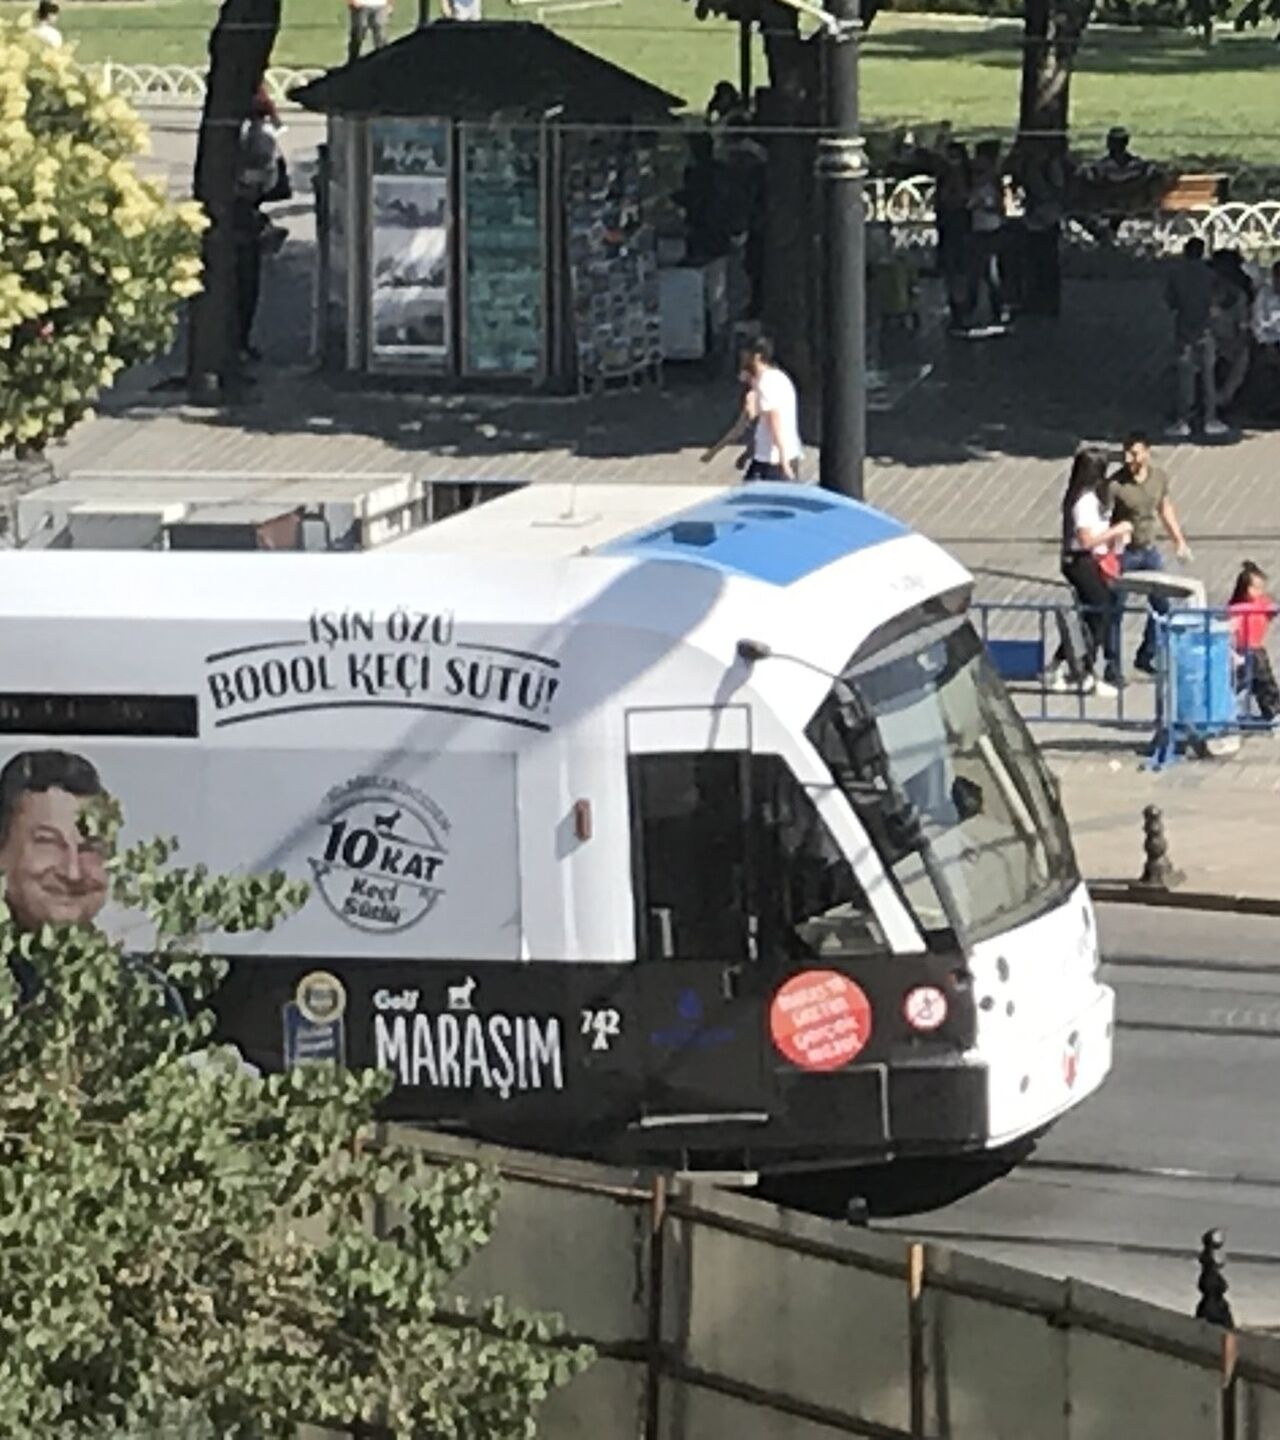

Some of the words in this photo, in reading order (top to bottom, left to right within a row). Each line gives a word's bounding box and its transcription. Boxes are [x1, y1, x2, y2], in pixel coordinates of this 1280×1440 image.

[207, 654, 336, 709] BOOOL
[323, 820, 379, 870] 10
[380, 846, 444, 882] KAT
[374, 1013, 564, 1100] MARAŞIM
